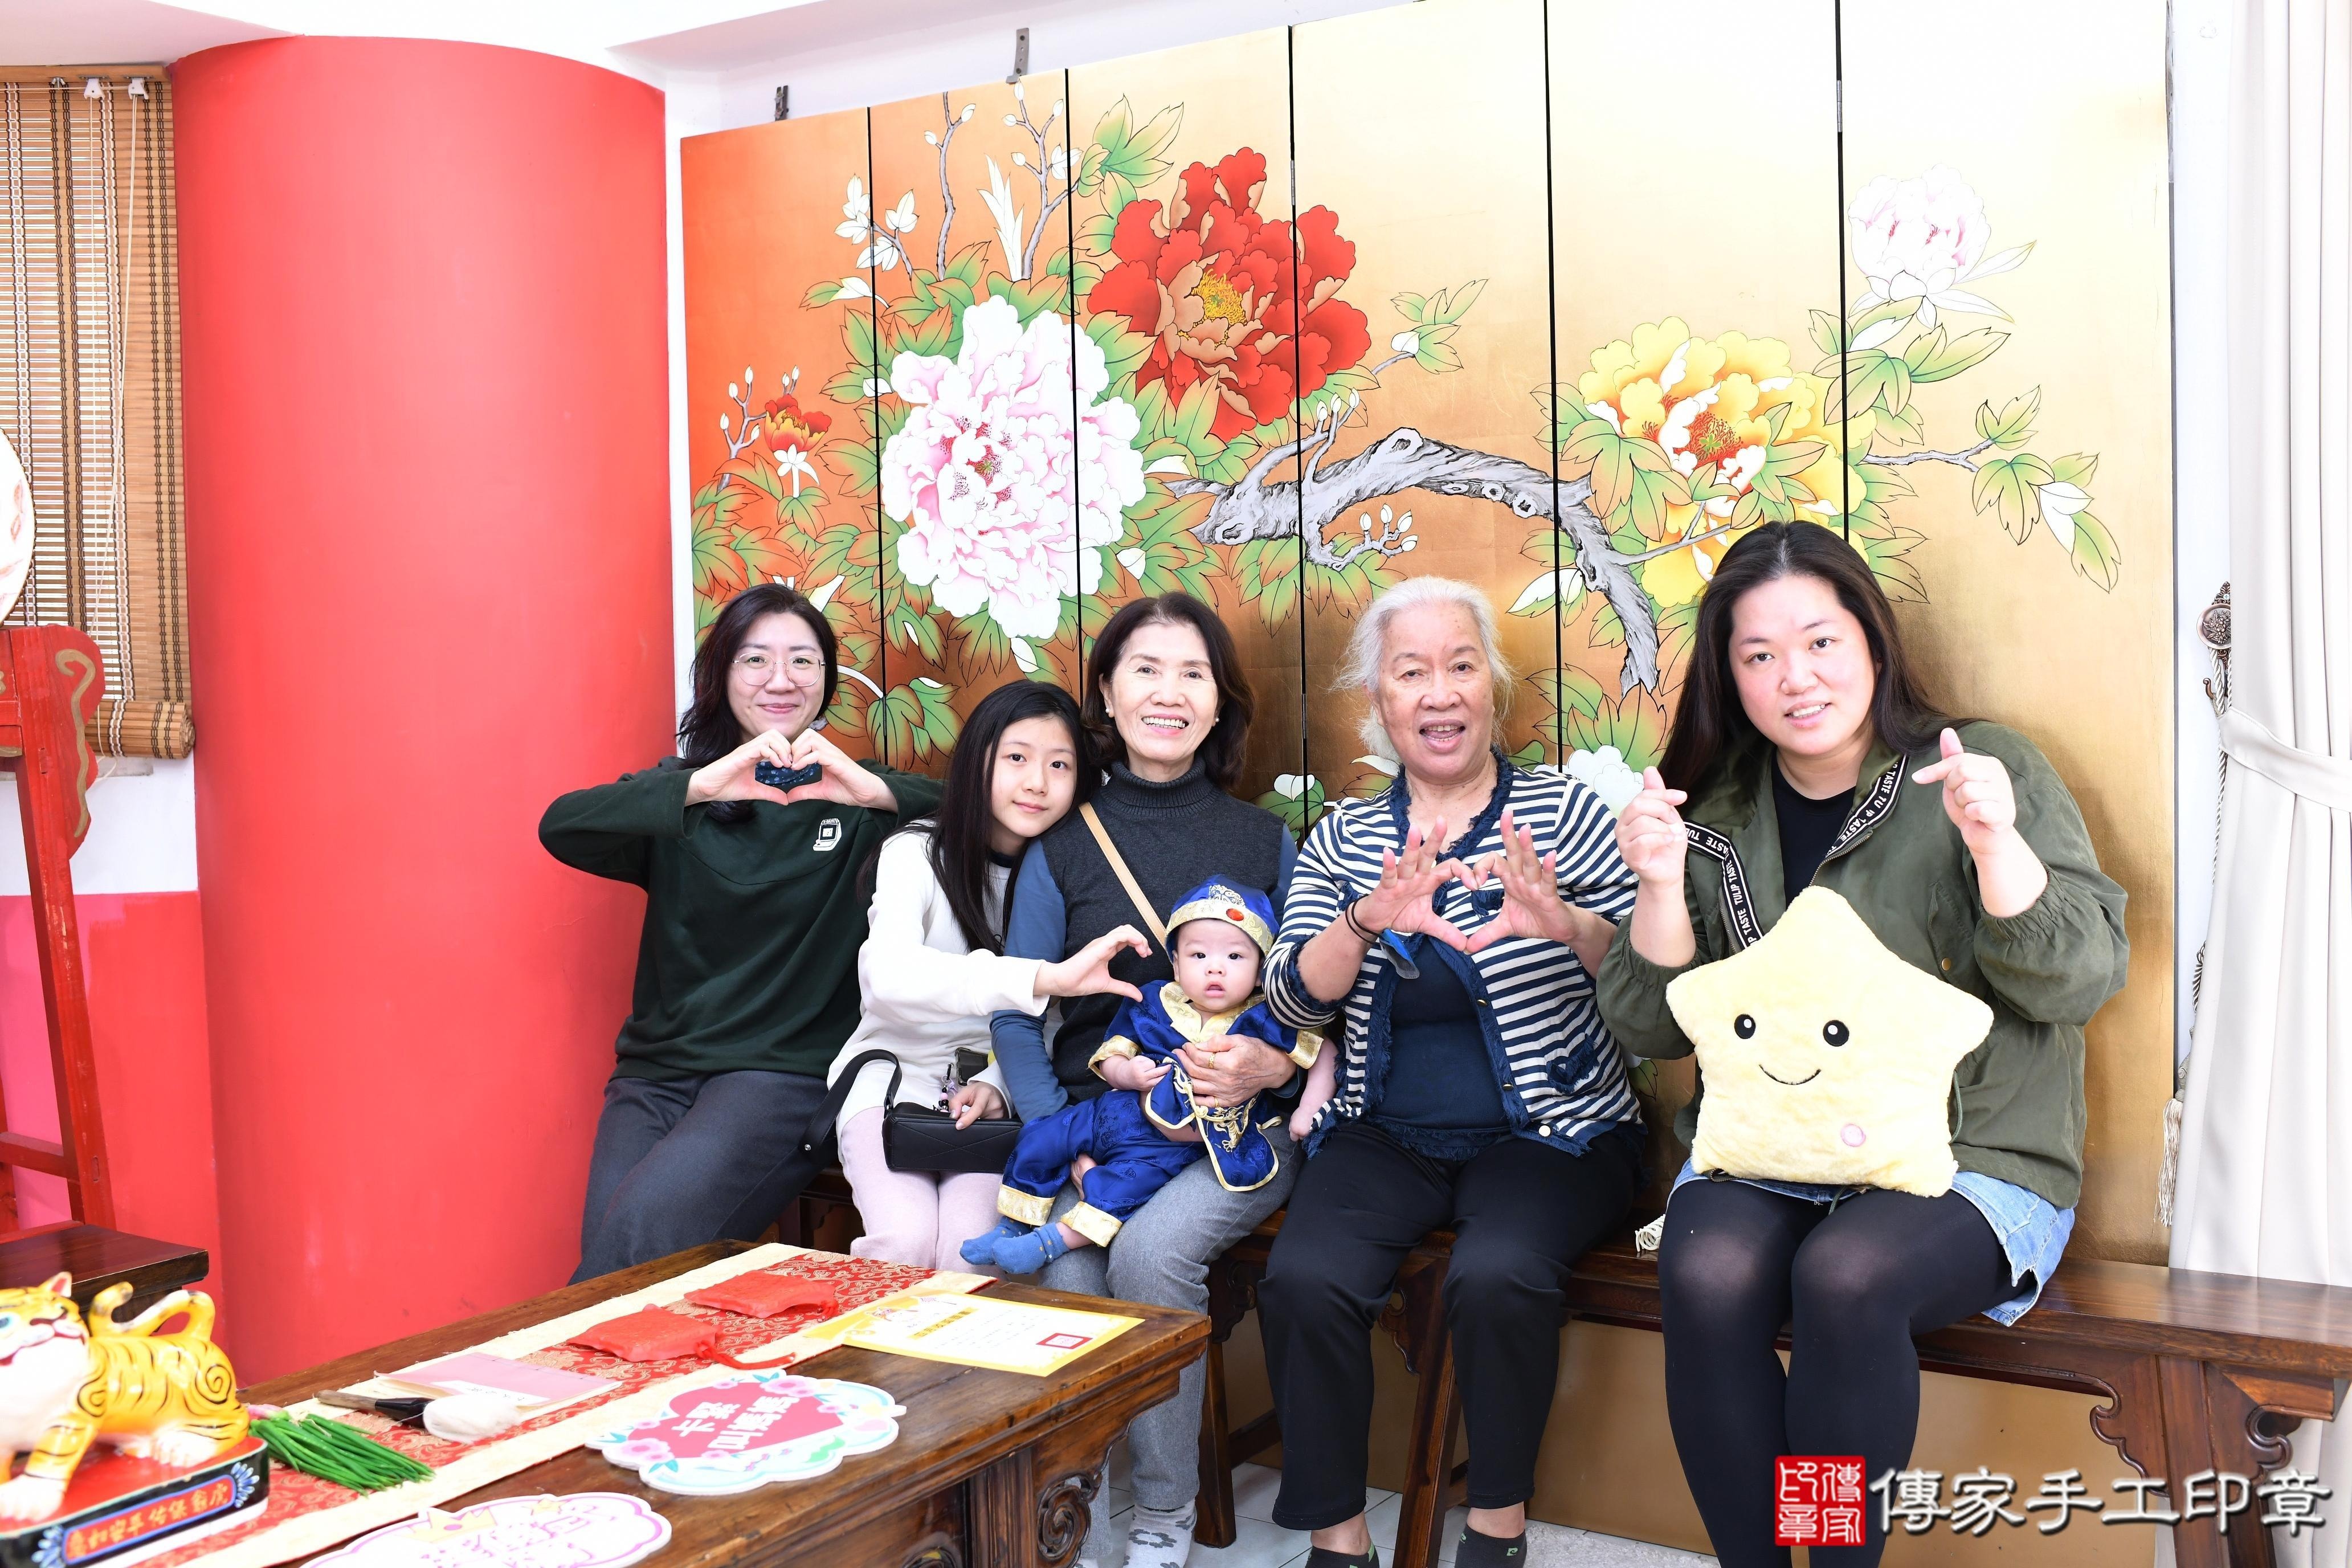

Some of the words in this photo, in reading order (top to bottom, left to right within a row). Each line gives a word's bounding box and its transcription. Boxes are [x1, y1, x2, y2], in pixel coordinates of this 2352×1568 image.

[1881, 771, 1896, 794] TASTE
[1865, 795, 1887, 817] TUIP
[1705, 836, 1729, 855] ASTE
[1726, 859, 1737, 883] TASTE
[1730, 884, 1743, 905] TULIP
[1737, 908, 1752, 935] TASTE
